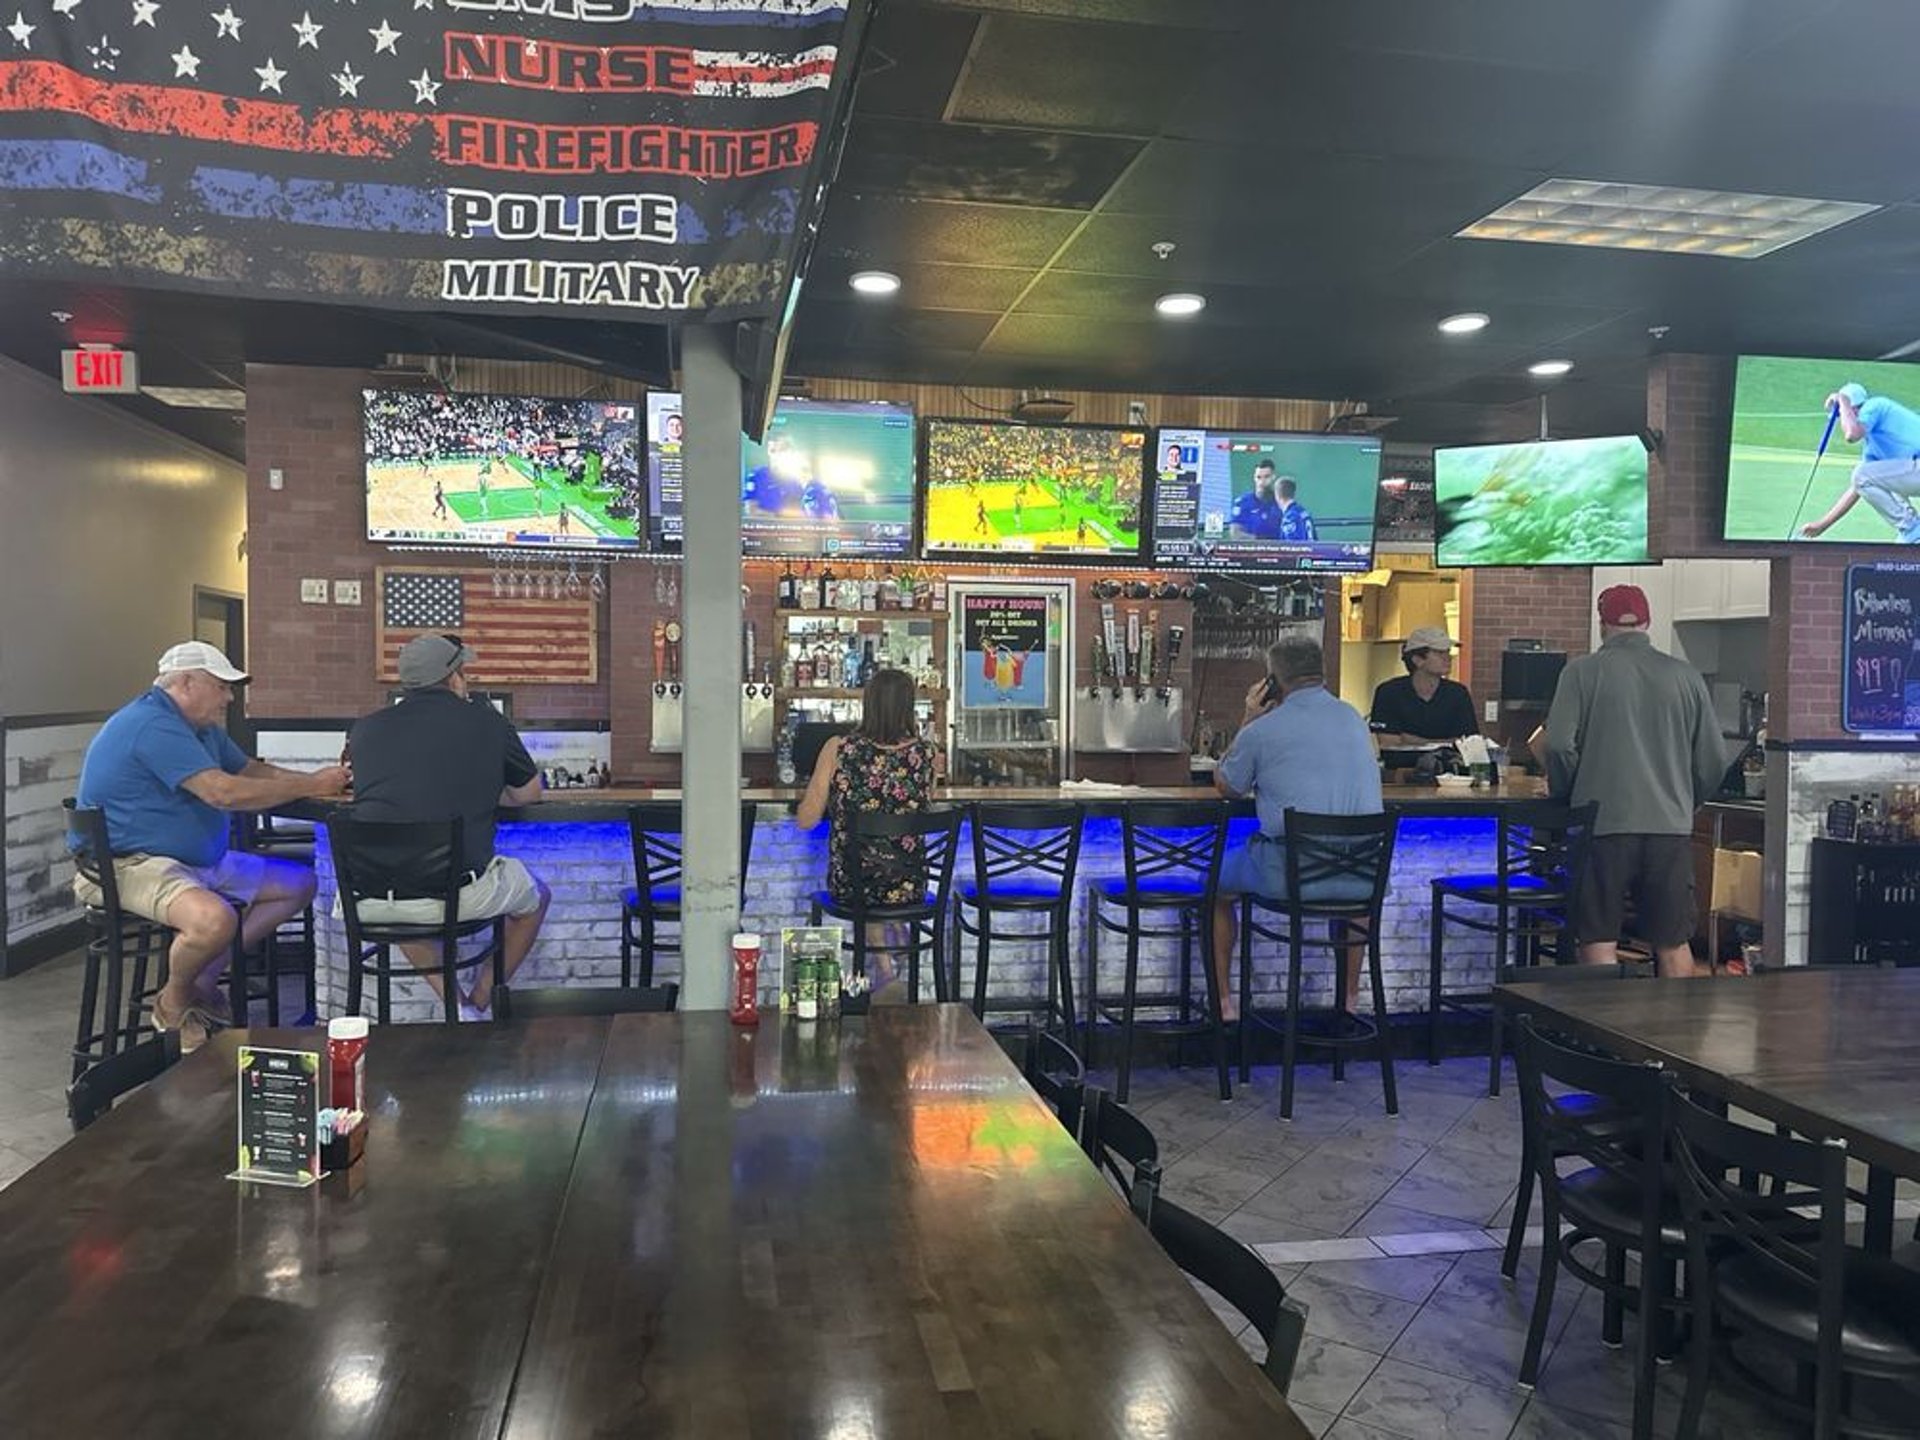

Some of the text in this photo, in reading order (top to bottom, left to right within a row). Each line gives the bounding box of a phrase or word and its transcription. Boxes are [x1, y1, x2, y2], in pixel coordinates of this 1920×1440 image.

[444, 31, 695, 95] NURSE
[445, 113, 803, 177] FIREFIGHTER
[446, 187, 678, 243] POLICE
[441, 258, 700, 310] MILITARY
[75, 351, 124, 388] EXIT
[967, 599, 1007, 609] HAPPY
